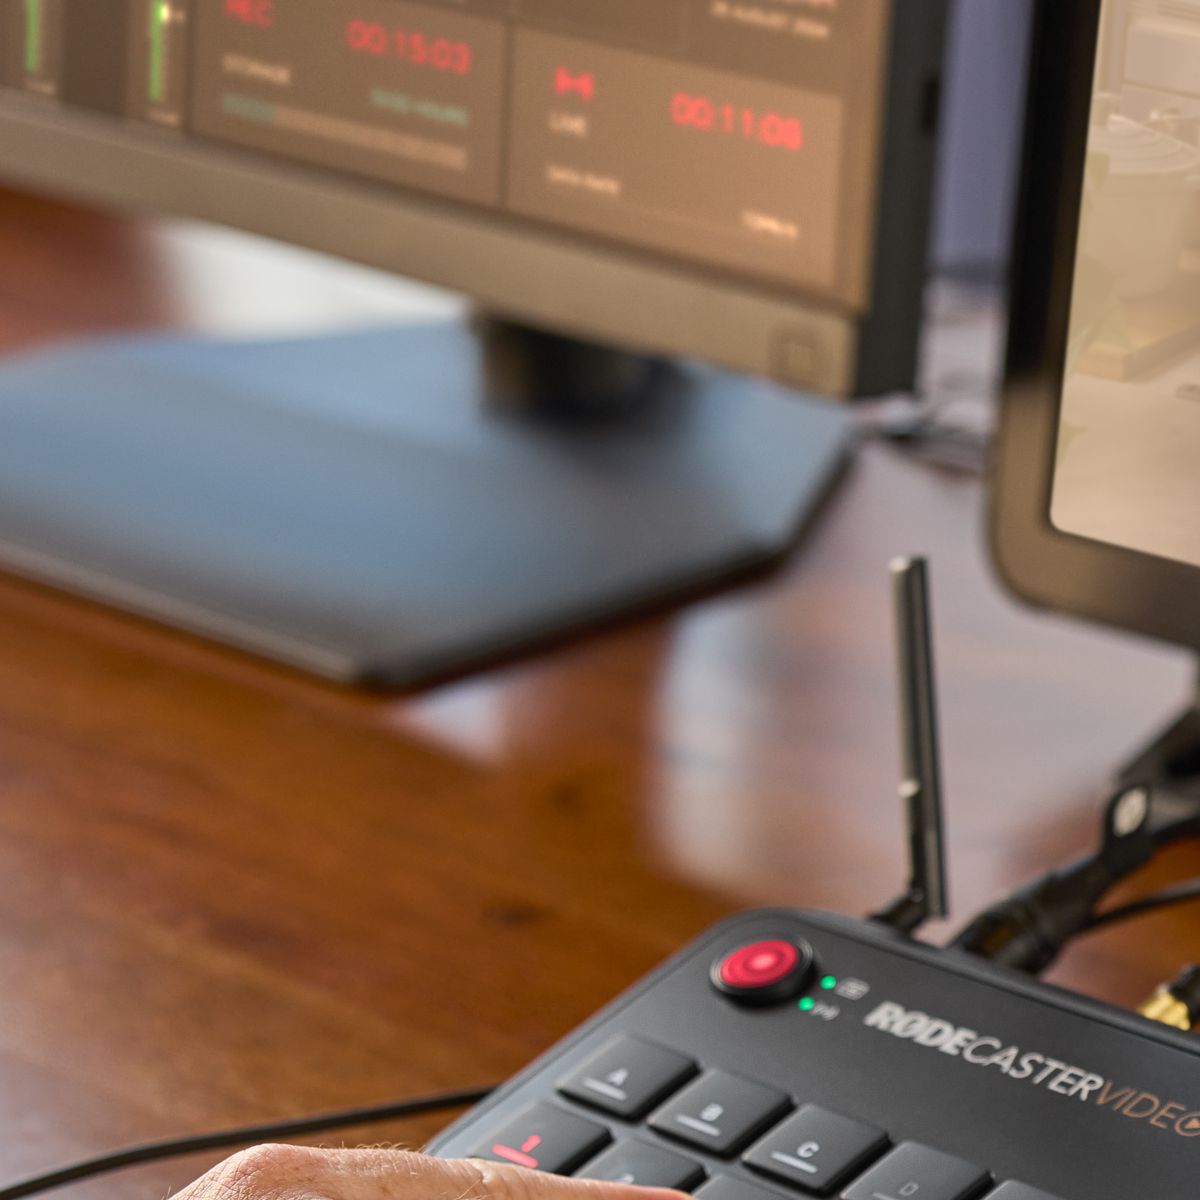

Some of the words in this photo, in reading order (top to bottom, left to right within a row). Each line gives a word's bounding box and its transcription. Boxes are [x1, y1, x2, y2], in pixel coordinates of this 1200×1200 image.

[607, 1067, 629, 1086] A
[701, 1103, 723, 1122] B
[797, 1141, 820, 1158] C
[899, 1182, 919, 1197] D
